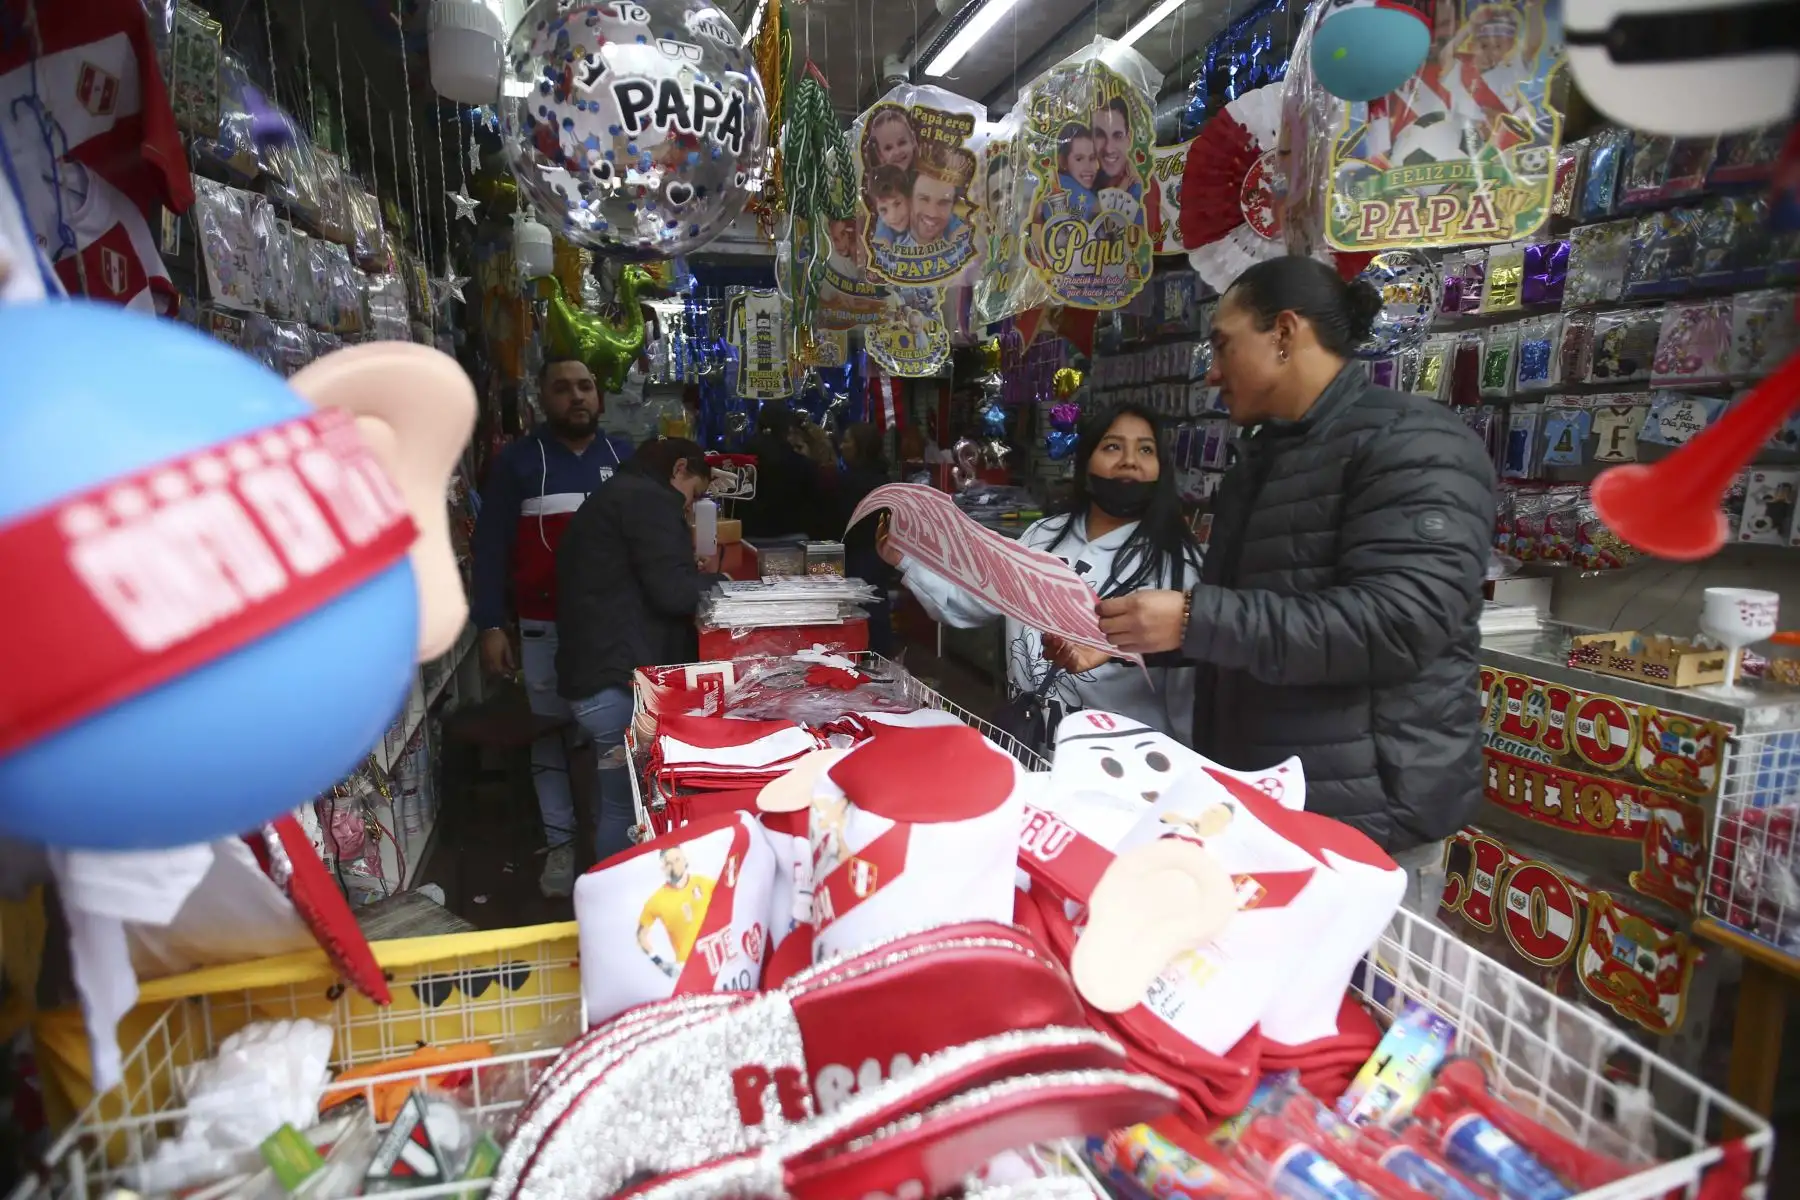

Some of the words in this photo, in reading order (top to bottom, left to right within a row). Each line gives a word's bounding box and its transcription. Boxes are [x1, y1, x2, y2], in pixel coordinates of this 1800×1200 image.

[609, 1, 650, 22] Te
[920, 127, 932, 138] el
[934, 129, 957, 145] Rey
[1391, 165, 1444, 186] FELIZ
[894, 244, 925, 256] FELIZ
[1611, 426, 1630, 449] F
